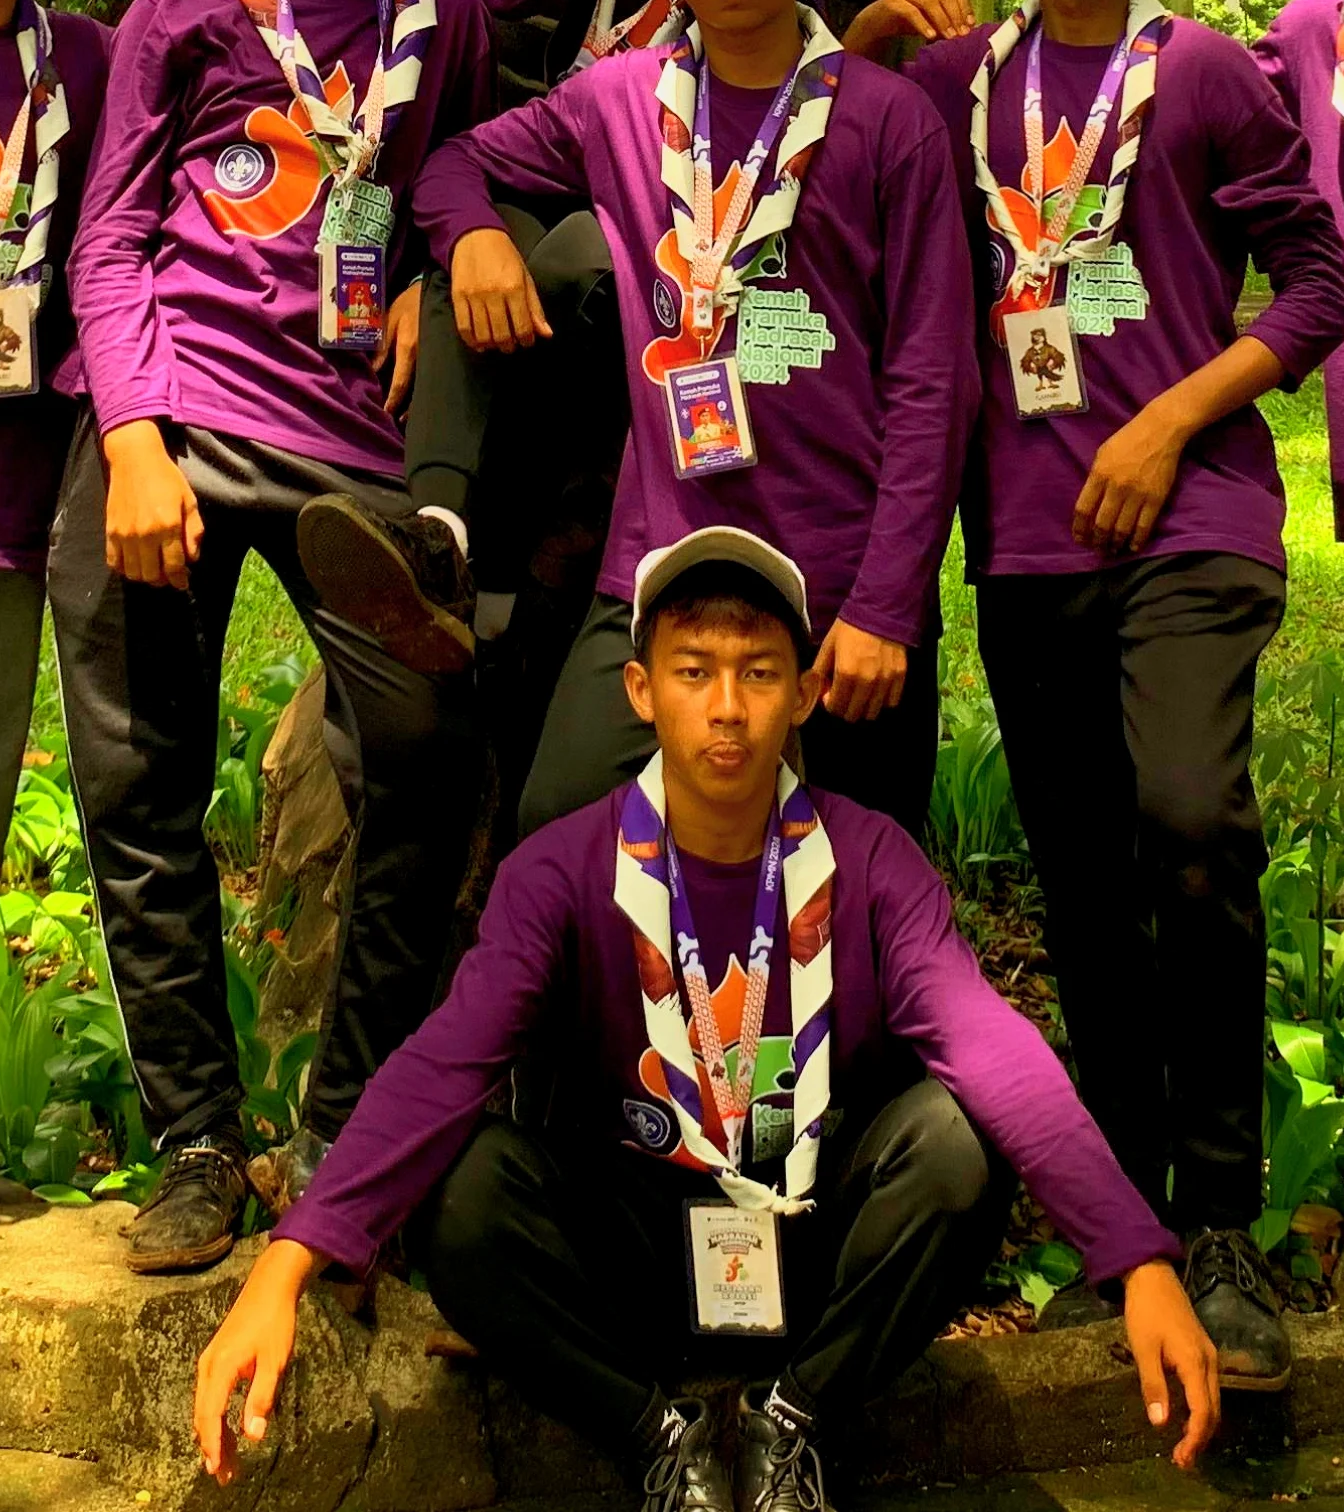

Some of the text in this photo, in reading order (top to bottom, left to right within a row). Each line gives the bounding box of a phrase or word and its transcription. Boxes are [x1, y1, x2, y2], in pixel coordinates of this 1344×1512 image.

[739, 288, 808, 307] Kemah
[1068, 298, 1143, 317] Nasional
[739, 306, 824, 328] Pramuka
[739, 325, 834, 348] Madrasah
[738, 343, 820, 366] Nasional
[739, 363, 787, 382] 2024
[765, 836, 781, 892] KPMN 2024
